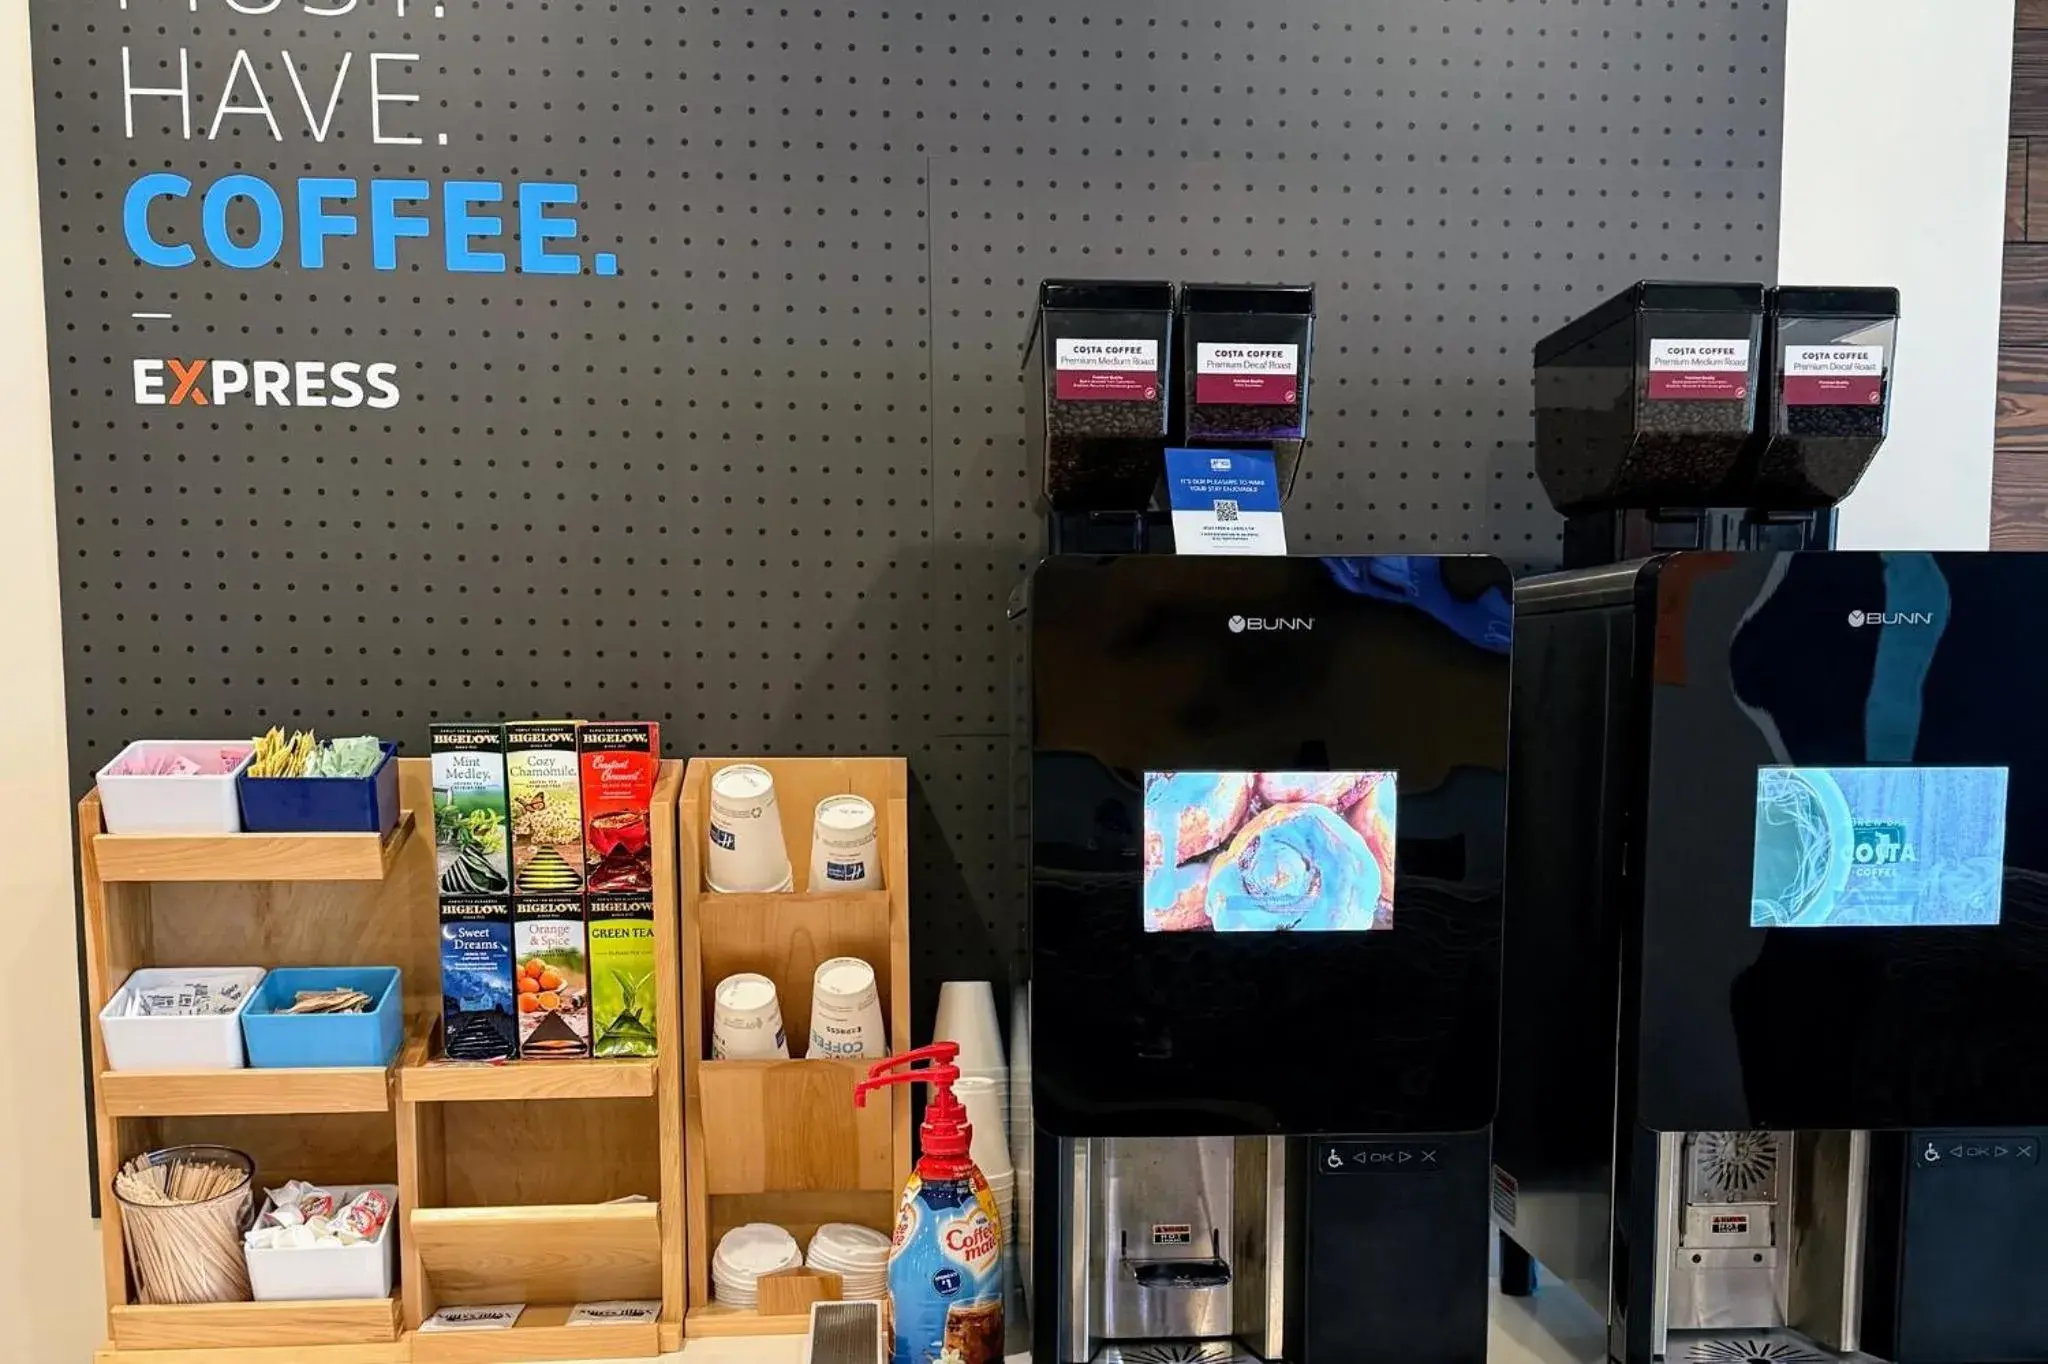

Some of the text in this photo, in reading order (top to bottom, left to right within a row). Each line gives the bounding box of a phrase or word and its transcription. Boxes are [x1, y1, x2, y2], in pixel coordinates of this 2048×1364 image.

[121, 47, 448, 146] HAVE.
[122, 173, 618, 276] COFFEE.
[1073, 346, 1142, 354] COSTA COFFEE
[1214, 350, 1284, 358] COSTA COFFEE
[1667, 347, 1735, 355] COSTA COFFEE
[1802, 352, 1869, 360] COSTA COFFEE
[1060, 357, 1097, 366] Premium
[1133, 357, 1155, 366] Roast
[1206, 360, 1242, 369] Premium
[1269, 360, 1292, 369] Roast
[1654, 357, 1690, 366] Premium
[1793, 362, 1828, 371] Premium
[1854, 362, 1877, 371] Roast
[133, 359, 400, 409] EXPRESS
[1866, 612, 1933, 624] BUNN
[1247, 617, 1313, 630] BUNN
[453, 755, 480, 767] Mint
[527, 755, 556, 768] Cozy
[458, 927, 490, 938] Sweet
[529, 924, 570, 937] Orange
[592, 928, 655, 938] GREEN TEA
[530, 935, 570, 949] & Spice
[1370, 1153, 1395, 1161] OK
